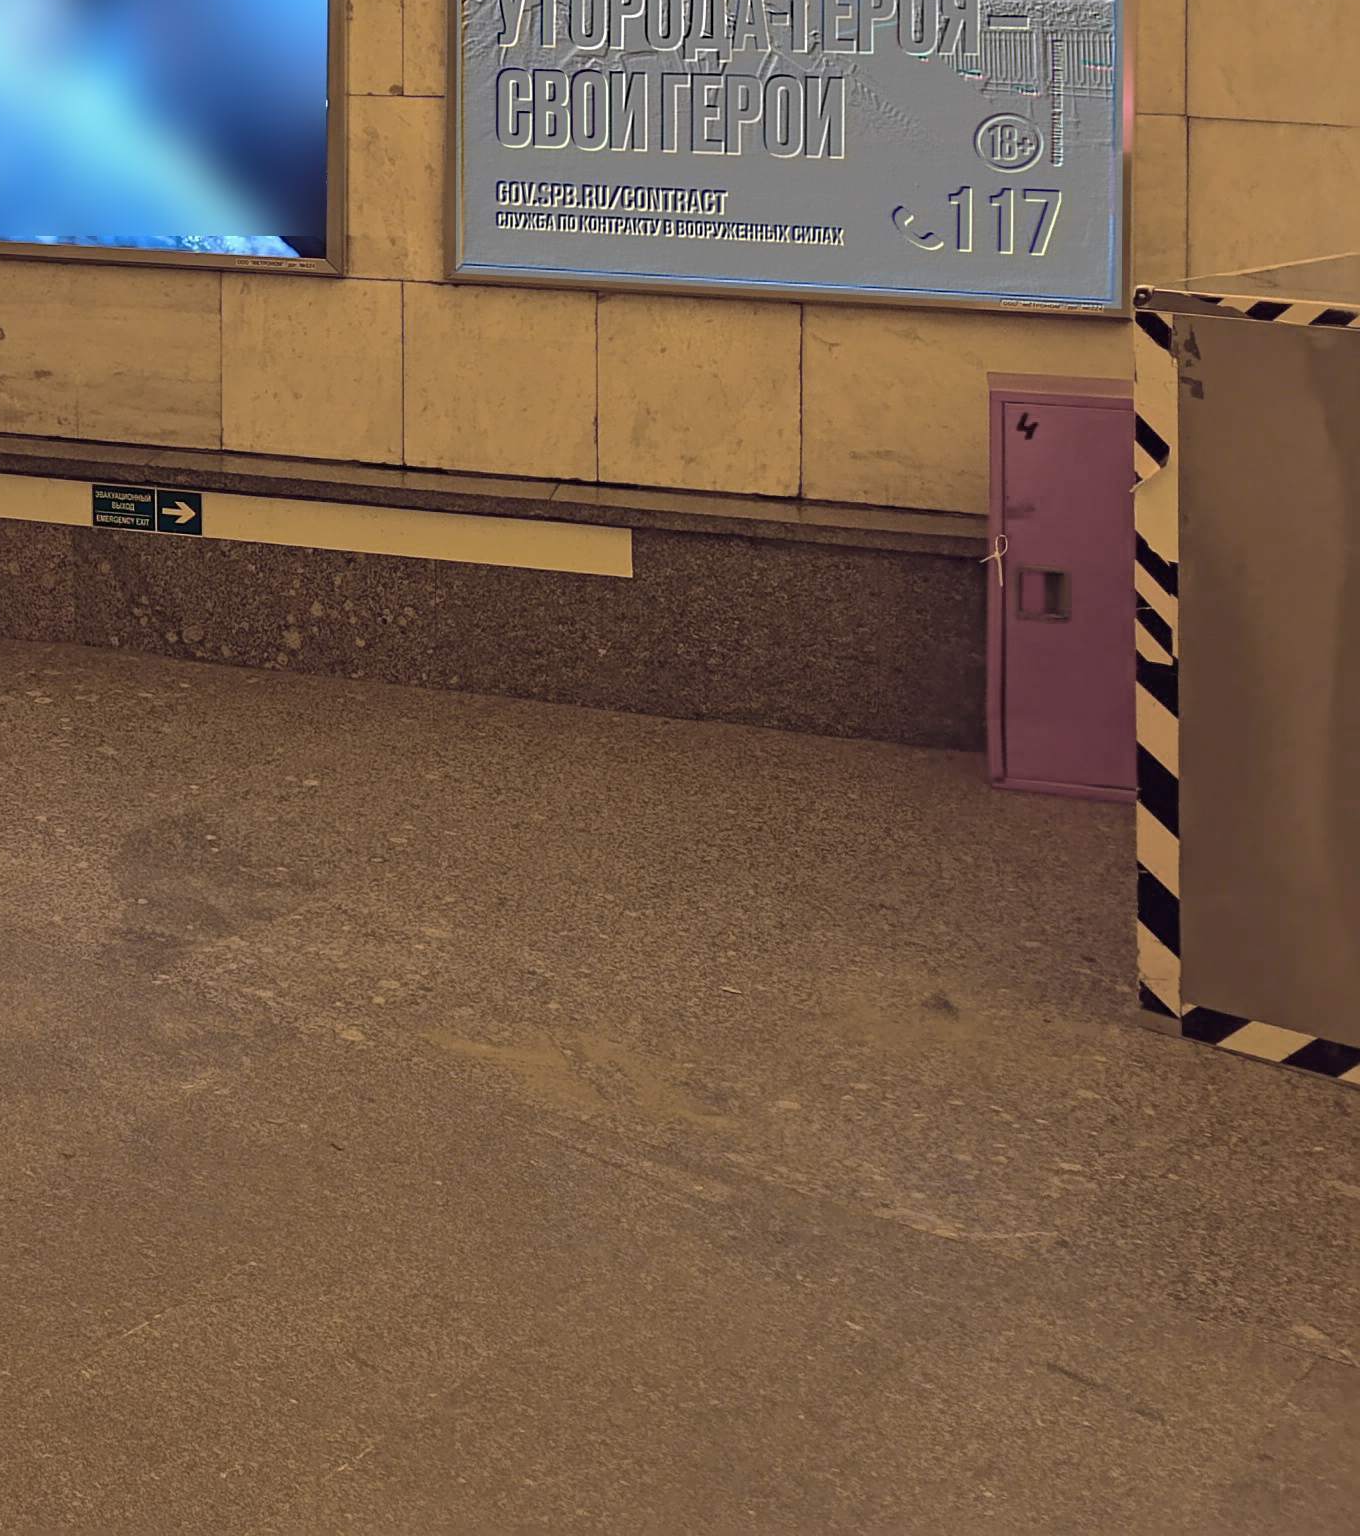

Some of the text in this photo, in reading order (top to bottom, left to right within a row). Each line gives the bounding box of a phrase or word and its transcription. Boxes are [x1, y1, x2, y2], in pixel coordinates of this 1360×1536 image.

[496, 67, 847, 162] СВОИ ГЕРОИ
[987, 124, 1036, 161] 18+
[496, 180, 728, 216] GOV.SPB.RU/CONTRACT
[496, 211, 845, 246] СЛУЖБА ПО КОНТРАКТУ В ВООРУЖЕННЫХ СИЛАХ
[948, 185, 1062, 257] 117
[96, 514, 150, 526] EMERGENCY EXIT
